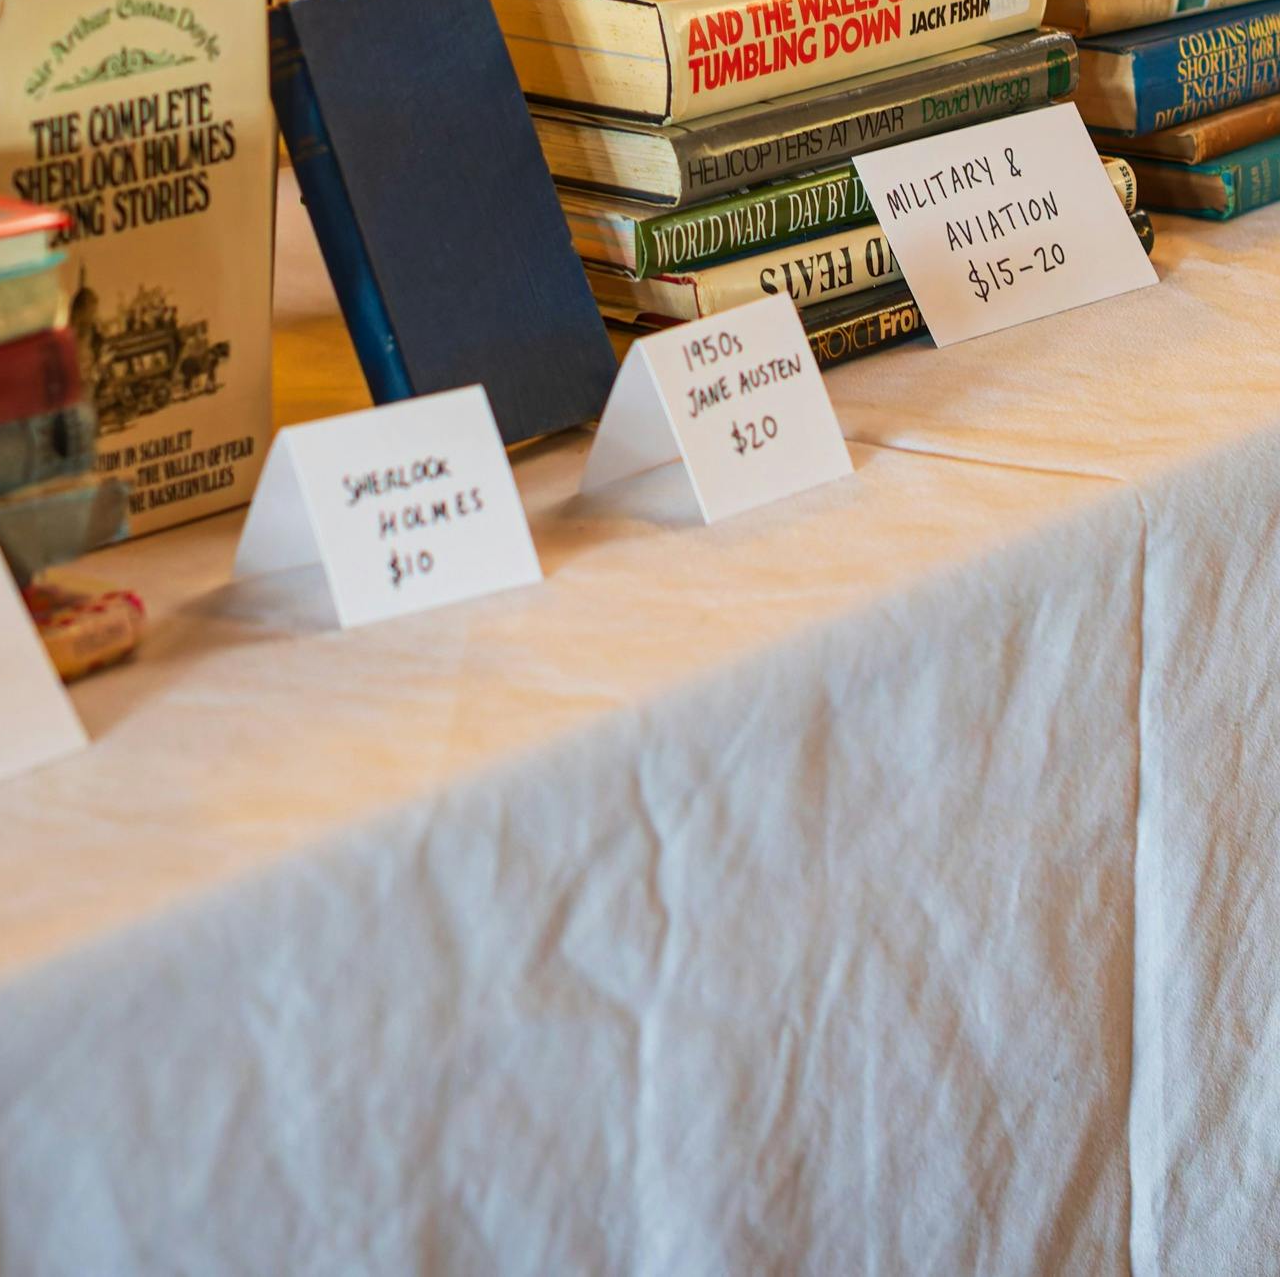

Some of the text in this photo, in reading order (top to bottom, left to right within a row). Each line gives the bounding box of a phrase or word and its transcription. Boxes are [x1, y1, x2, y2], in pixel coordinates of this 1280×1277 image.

[50, 6, 112, 63] Arthur
[688, 11, 745, 56] AND
[688, 26, 818, 95] TUMBLING
[823, 5, 902, 59] DOWN
[909, 5, 947, 37] JACK
[1177, 44, 1248, 83] SHORTER
[1251, 34, 1273, 62] 608
[1178, 19, 1248, 60] COLLINS
[1182, 65, 1248, 106] ENGLISH
[30, 82, 213, 161] THE COMPLETE
[688, 75, 1031, 190] HELICOPTERS AT WAR David Wragg
[12, 120, 236, 206] SHERLOCK HOLMES
[885, 146, 1023, 220] MILITARY &
[113, 172, 210, 233] STORIES
[653, 212, 723, 268] WORLD
[724, 204, 766, 246] WAR
[766, 199, 778, 237] I
[787, 189, 823, 232] DAY
[826, 180, 851, 222] BY
[945, 190, 1060, 251] AVIATION
[759, 247, 853, 300] FEATS
[967, 241, 1066, 304] $15-20
[681, 331, 744, 373] 1950s
[687, 353, 804, 419] JANE AUSTEN
[140, 429, 193, 461] SCARLET
[164, 451, 205, 479] VALLEY
[207, 446, 223, 466] OF
[223, 436, 255, 461] FEAR
[730, 415, 780, 458] $20
[148, 465, 235, 509] BASKERVILLES
[343, 456, 452, 507] SHERLOCK
[376, 487, 486, 540] HOLMES
[387, 550, 435, 589] $10
